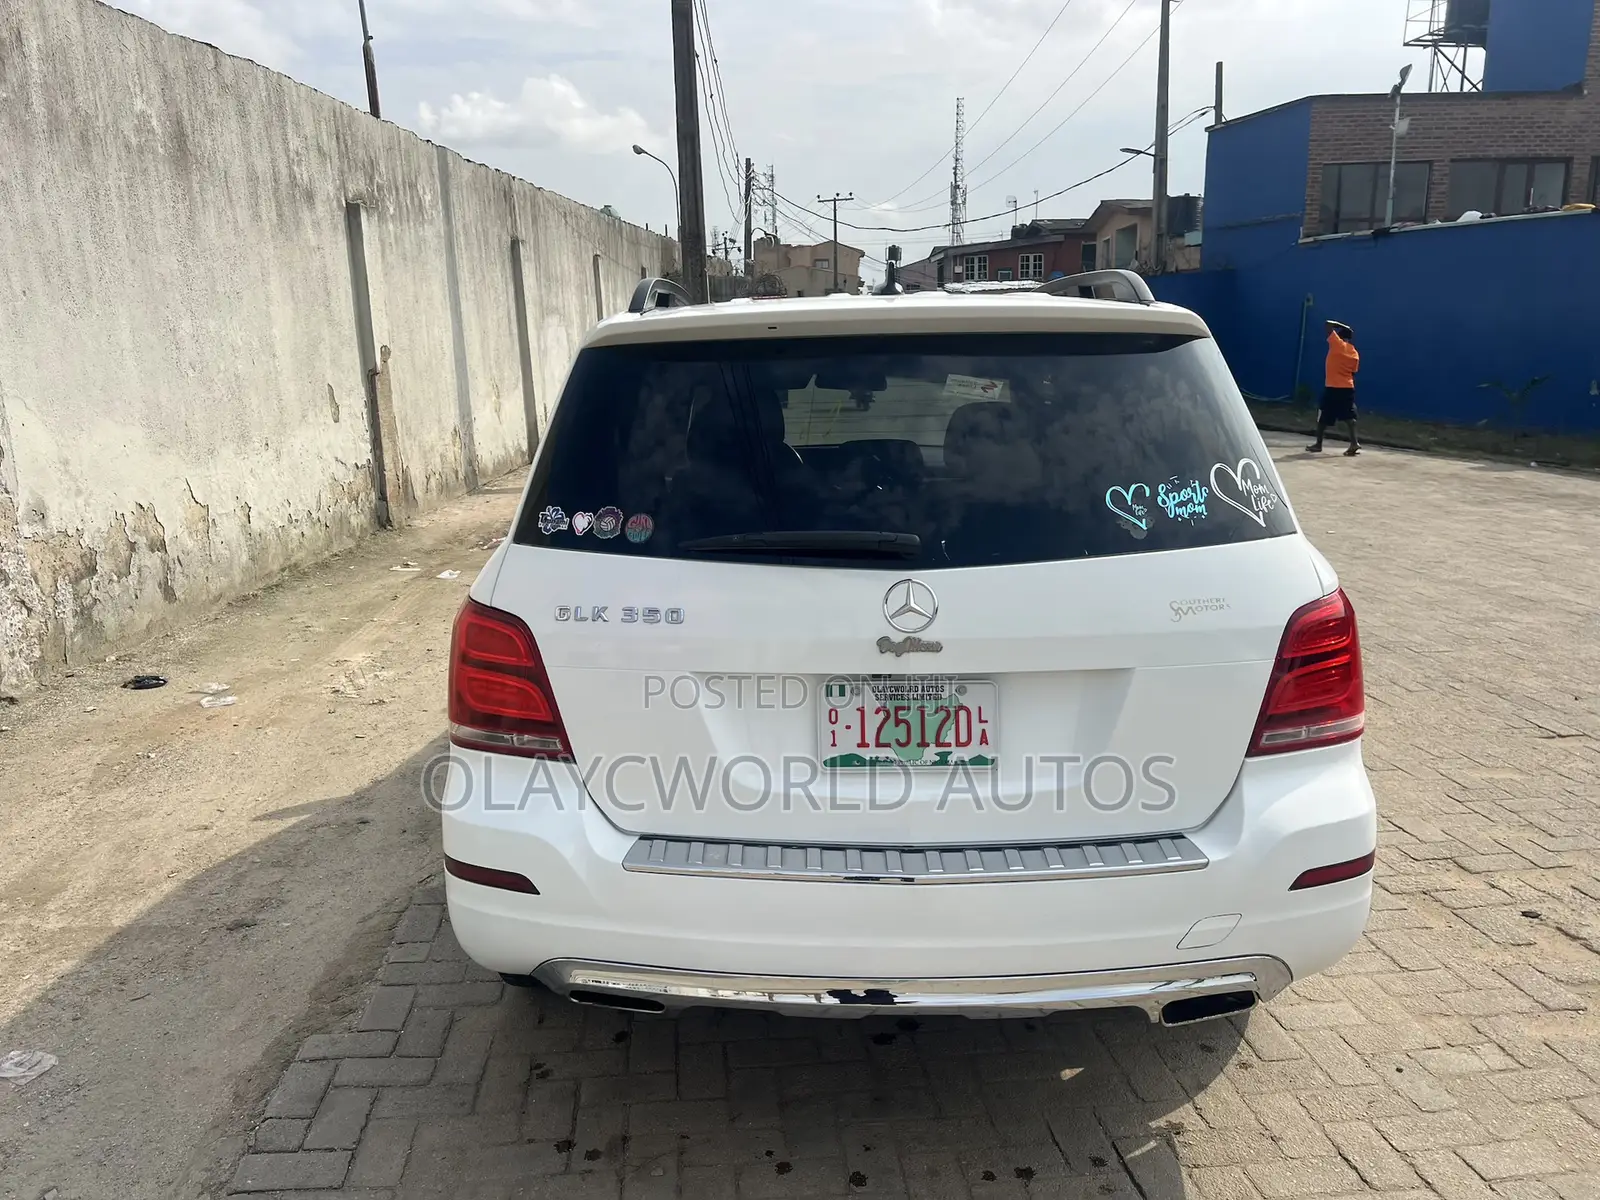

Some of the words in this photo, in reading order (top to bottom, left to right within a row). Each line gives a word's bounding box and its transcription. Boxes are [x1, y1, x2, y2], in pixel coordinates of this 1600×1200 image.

[555, 605, 609, 622] GLK
[621, 606, 685, 624] 350
[921, 685, 945, 693] AUTOS
[874, 693, 910, 701] SERVICES
[912, 693, 943, 701] LIMITED
